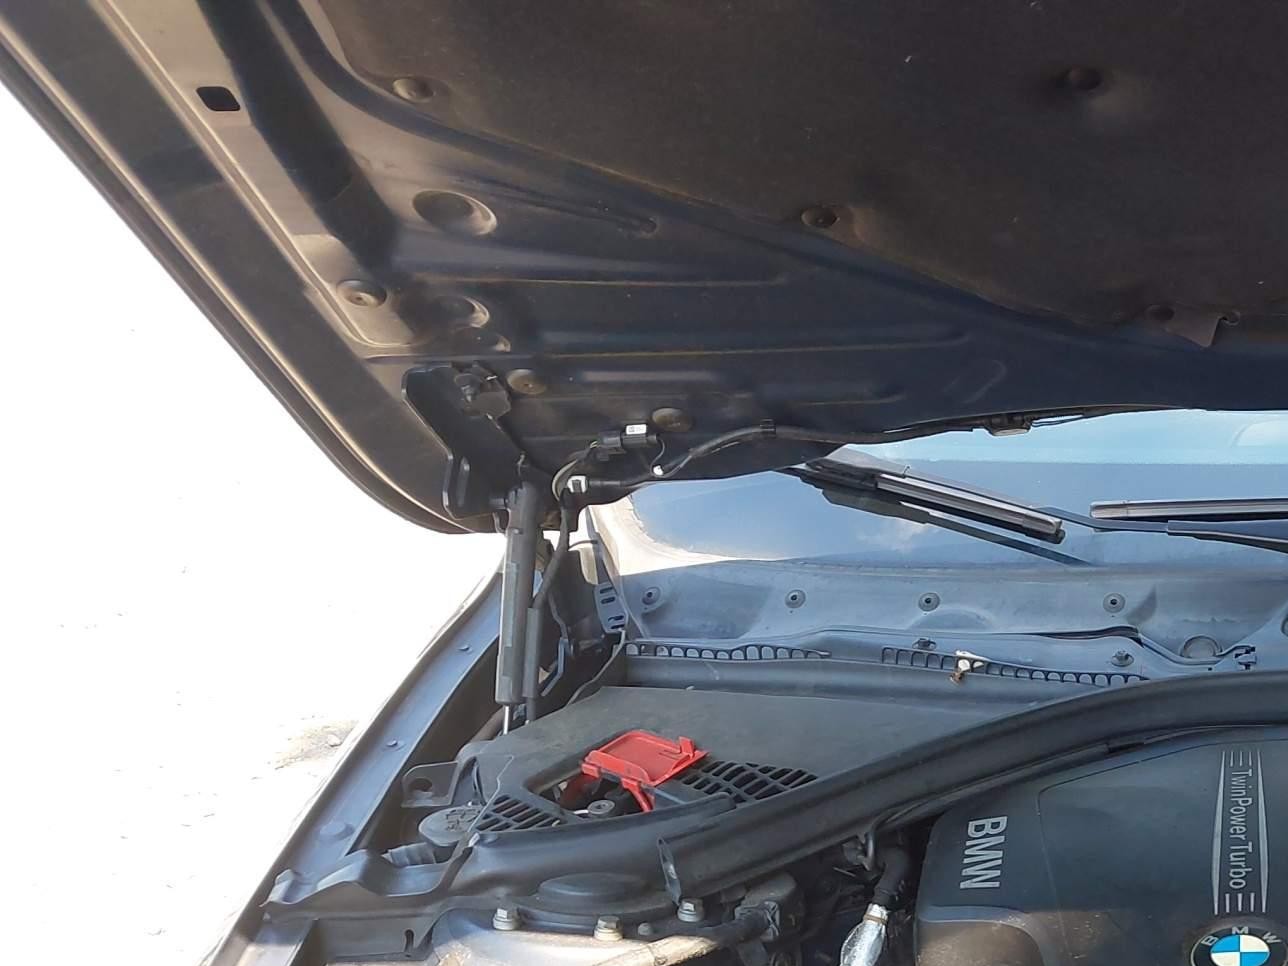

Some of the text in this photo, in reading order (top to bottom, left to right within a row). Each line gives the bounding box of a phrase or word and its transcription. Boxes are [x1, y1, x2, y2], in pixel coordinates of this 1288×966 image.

[959, 815, 1008, 889] BMW
[1228, 768, 1253, 889] TwinPower Turbo
[1200, 926, 1282, 946] BMW
